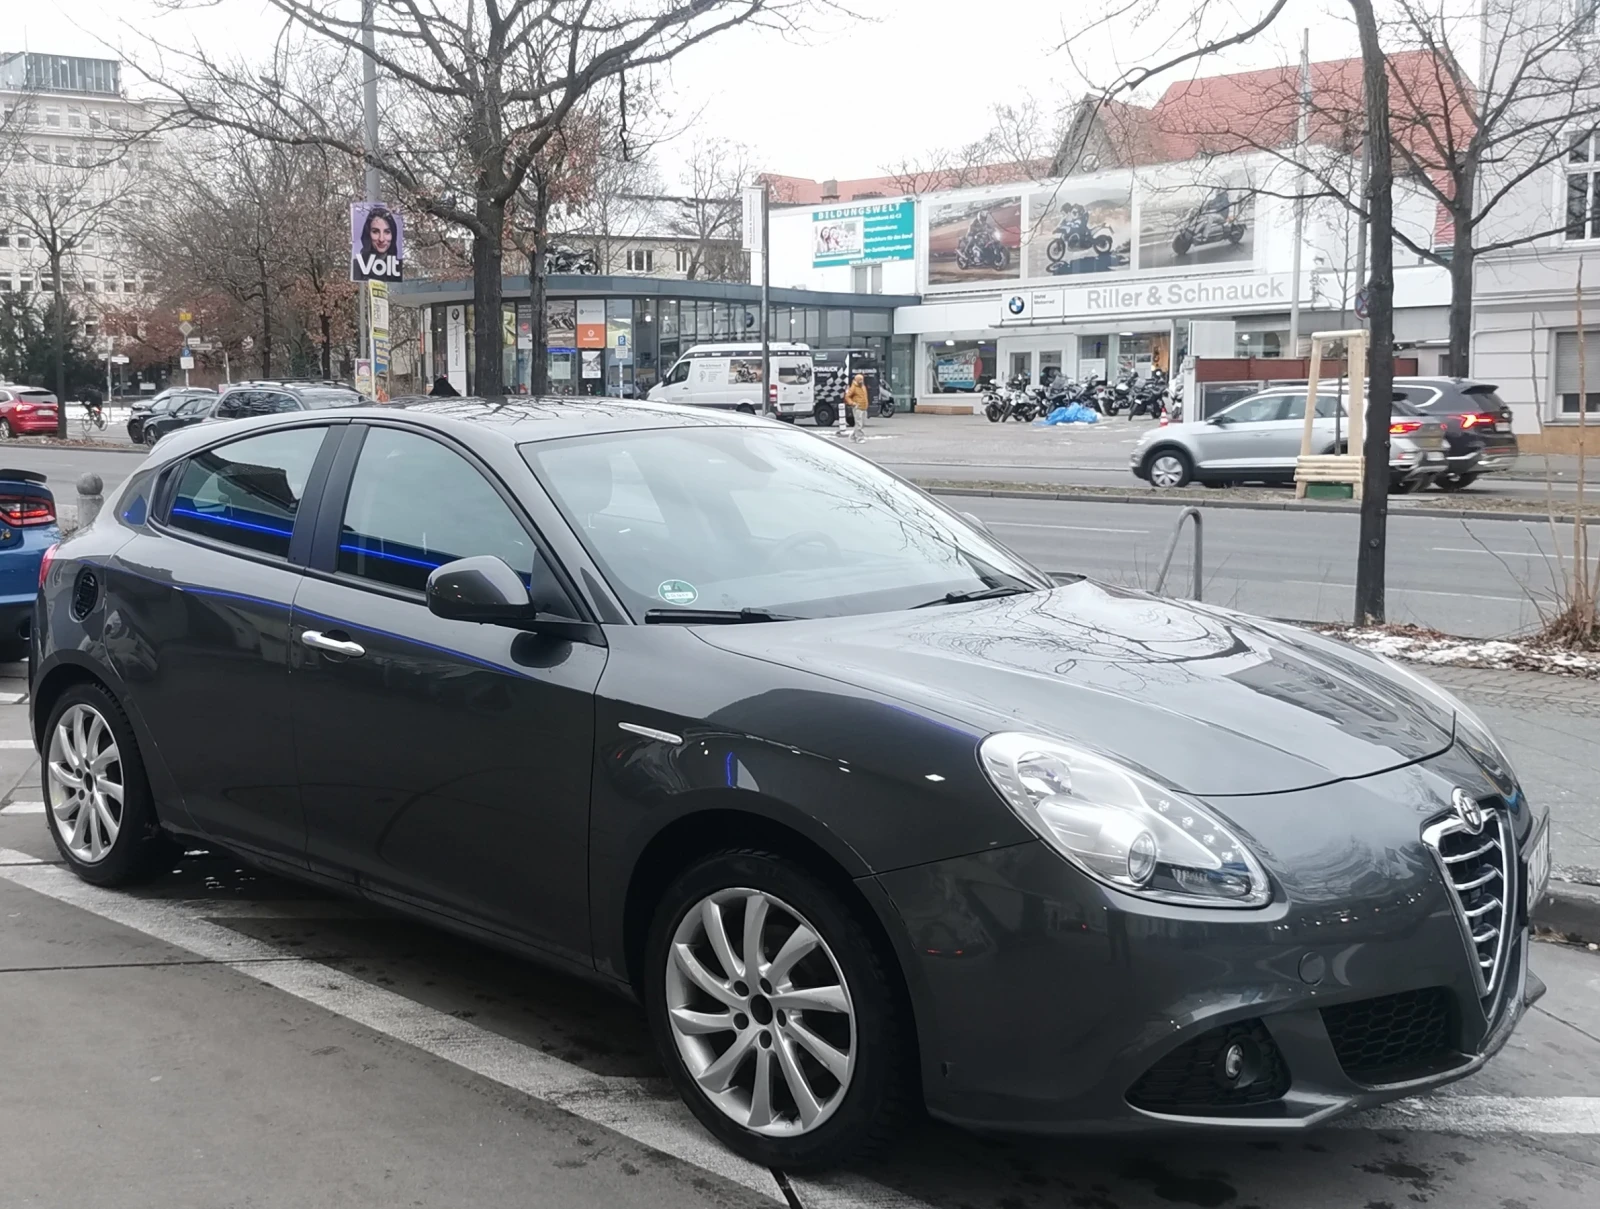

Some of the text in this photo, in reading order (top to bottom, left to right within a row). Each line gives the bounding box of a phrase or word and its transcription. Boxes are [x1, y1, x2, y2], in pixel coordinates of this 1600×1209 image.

[818, 203, 901, 220] BILDUNGSWELT
[355, 253, 401, 277] Volt
[1086, 276, 1285, 310] Riller & Schnauck
